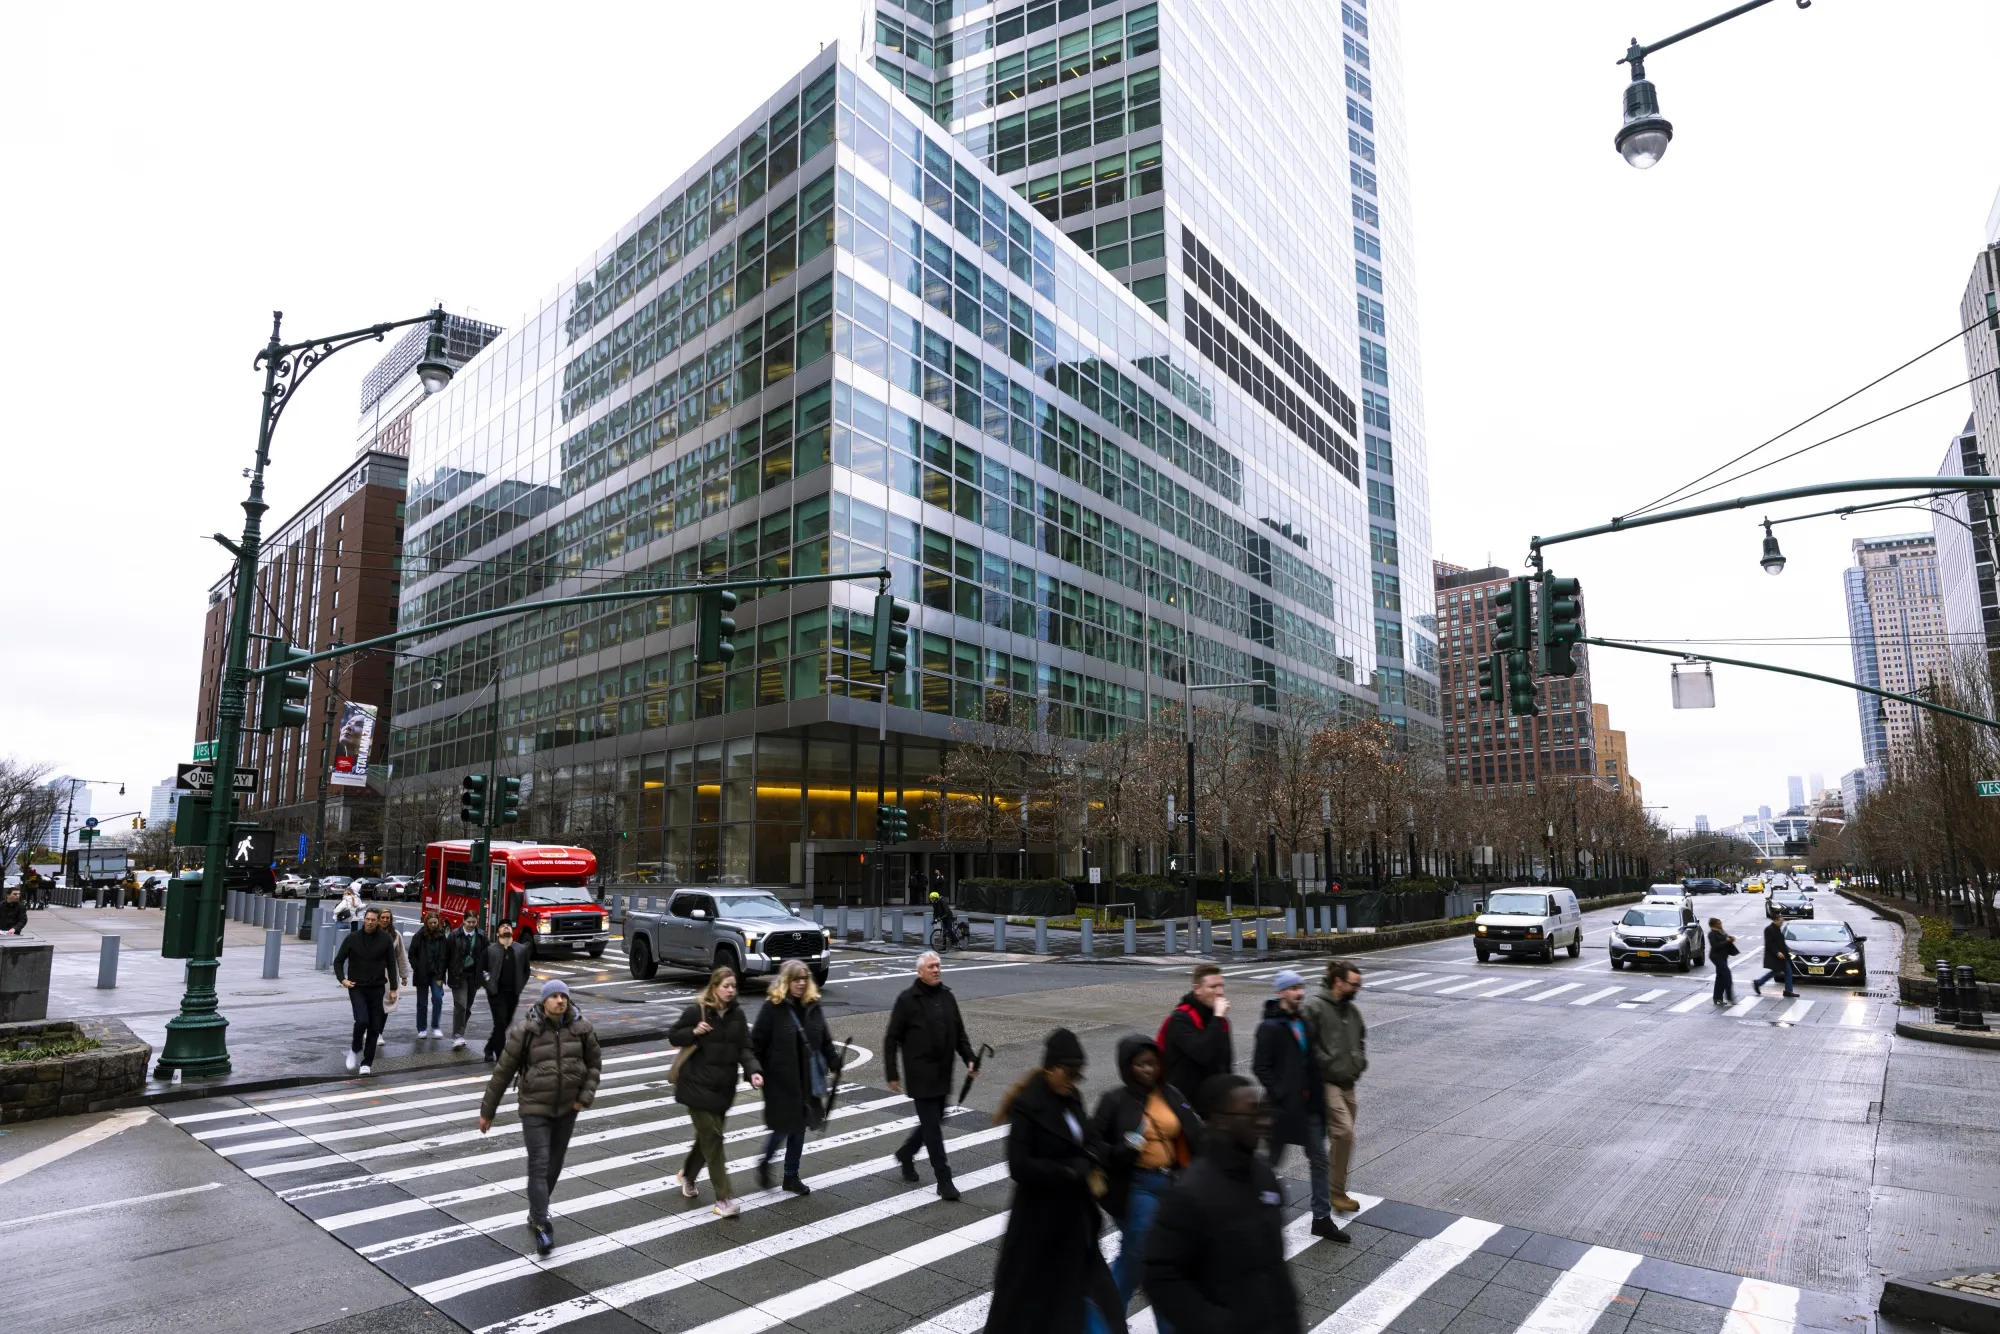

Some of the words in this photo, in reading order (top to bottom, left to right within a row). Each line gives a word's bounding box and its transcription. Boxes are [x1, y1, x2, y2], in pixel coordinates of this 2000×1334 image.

[359, 717, 374, 753] AMAZING
[355, 753, 368, 774] STAY
[190, 772, 214, 784] ONE
[233, 775, 249, 786] AY
